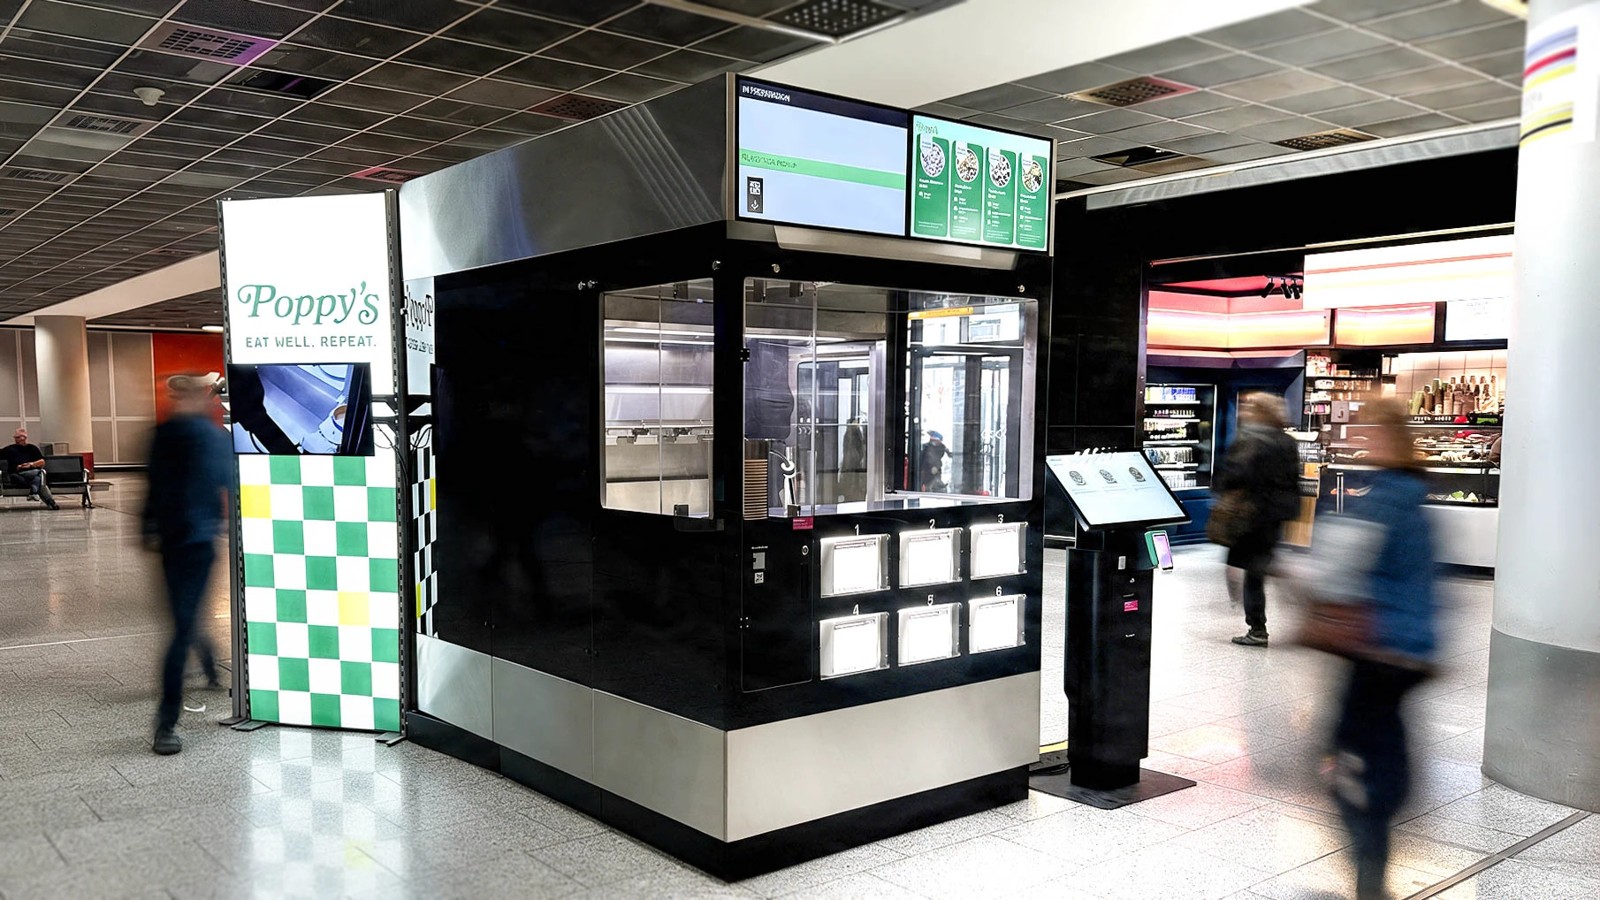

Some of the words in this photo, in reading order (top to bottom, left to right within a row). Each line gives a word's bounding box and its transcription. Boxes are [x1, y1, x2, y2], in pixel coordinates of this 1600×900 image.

[237, 281, 380, 325] Poppy's
[246, 337, 269, 348] EAT
[275, 336, 314, 347] WELL.
[321, 336, 376, 347] REPEAT.
[998, 514, 1004, 523] 3
[929, 519, 935, 529] 2
[854, 524, 859, 536] 1
[996, 586, 1002, 596] 6
[927, 595, 934, 605] 5
[853, 604, 859, 615] 4
